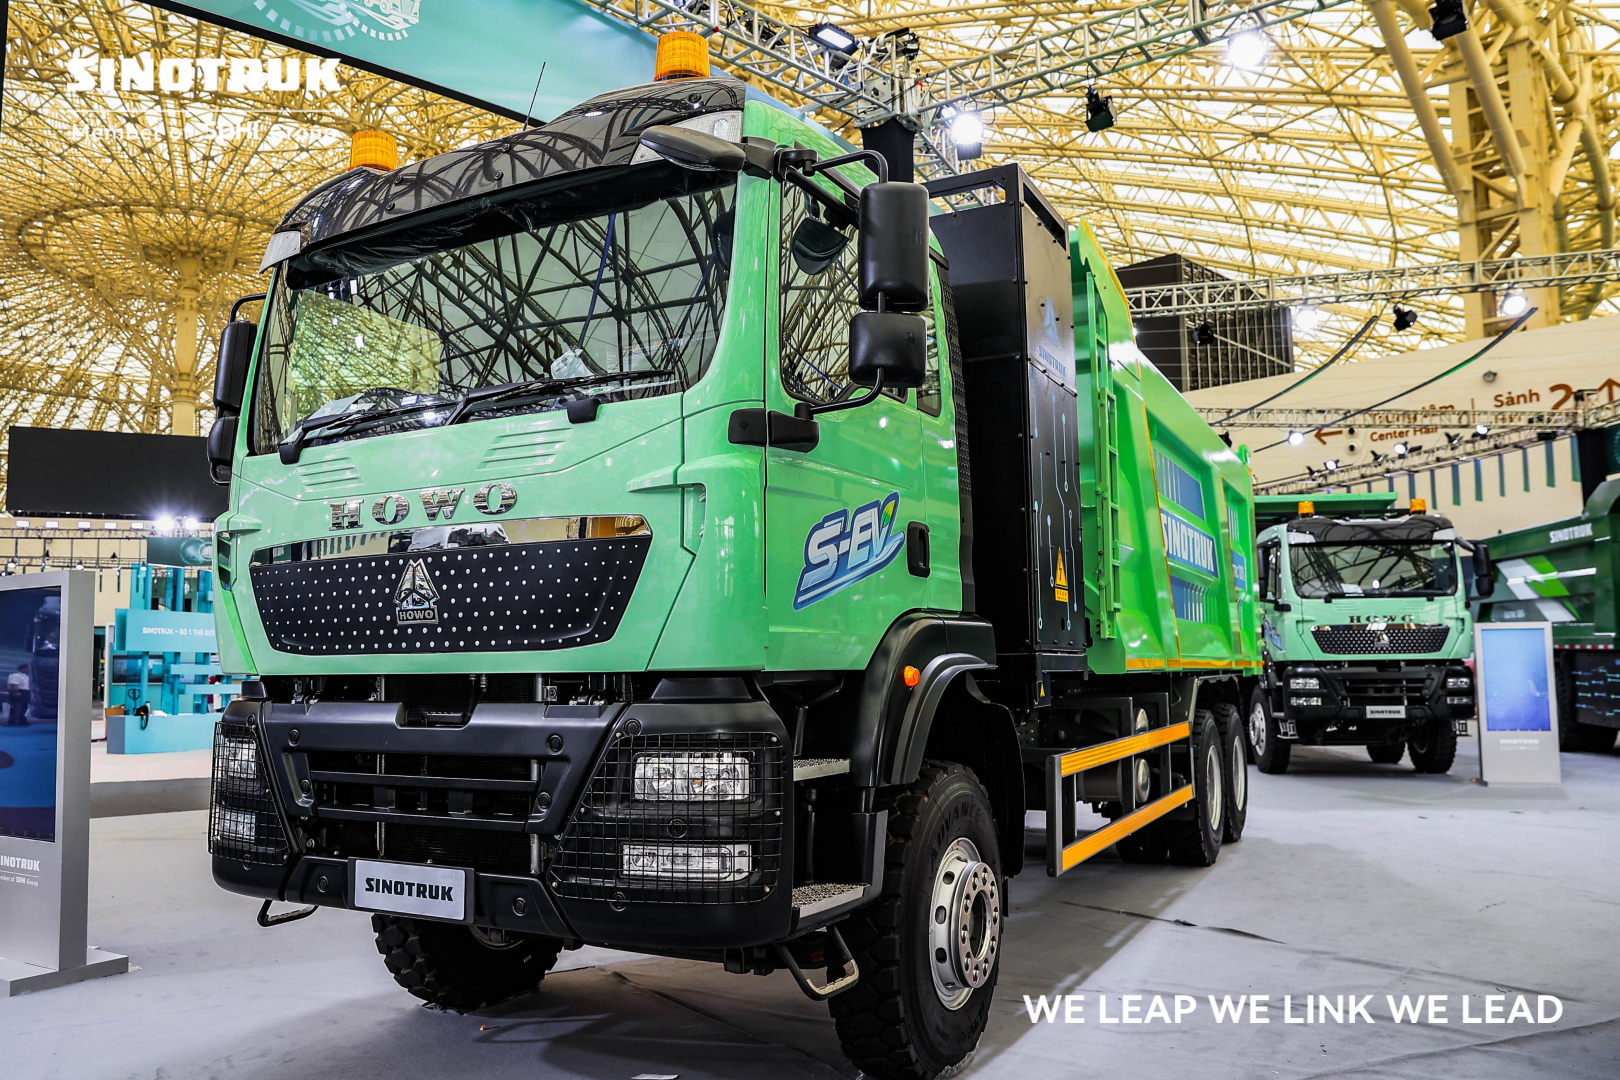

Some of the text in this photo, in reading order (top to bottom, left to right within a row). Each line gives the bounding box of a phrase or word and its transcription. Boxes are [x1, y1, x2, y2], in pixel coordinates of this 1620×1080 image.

[1493, 388, 1540, 408] Sảnh
[1370, 429, 1410, 441] Center
[328, 482, 518, 532] HOWO
[399, 609, 434, 621] HOWO
[1349, 614, 1416, 623] HOWO
[0, 855, 40, 871] INOTRUK
[365, 877, 454, 902] SINOTRUK
